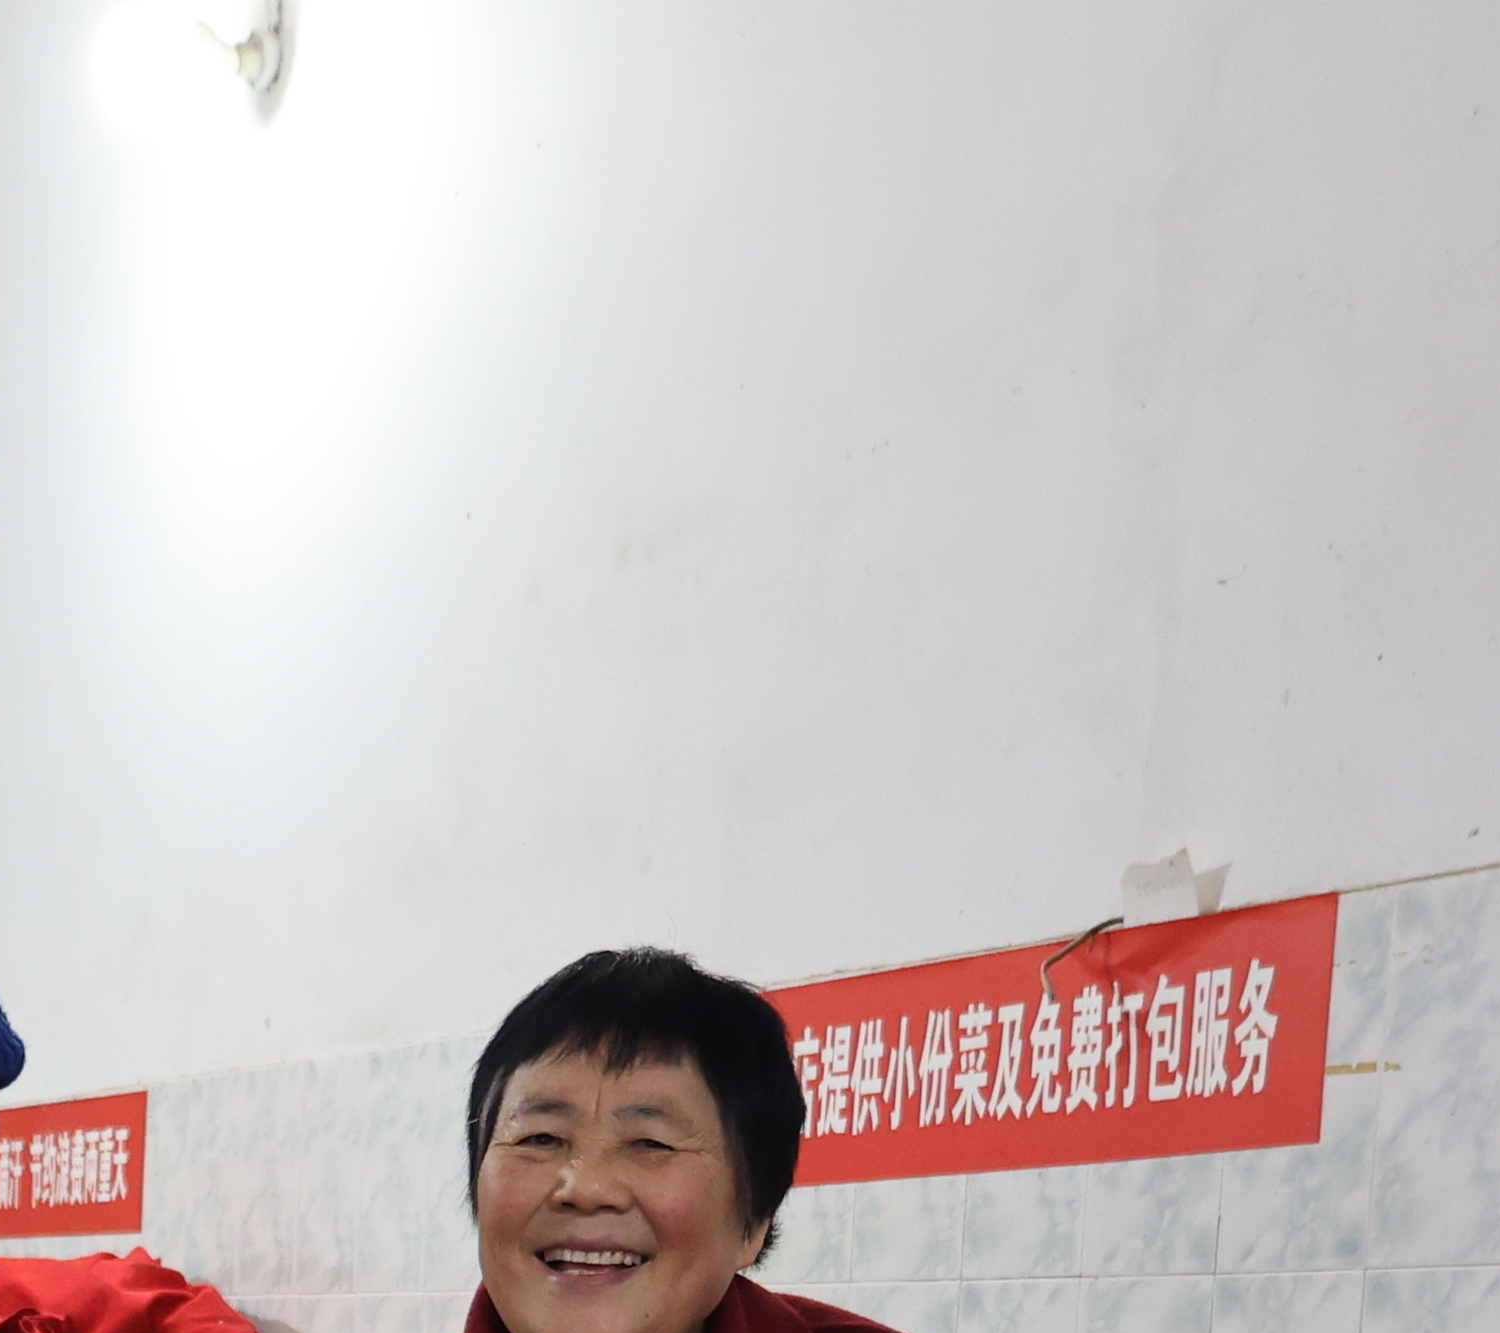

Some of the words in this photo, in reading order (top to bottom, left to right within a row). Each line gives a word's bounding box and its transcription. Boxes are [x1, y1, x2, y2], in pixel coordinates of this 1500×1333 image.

[29, 1126, 130, 1209] 节约浪费两重天
